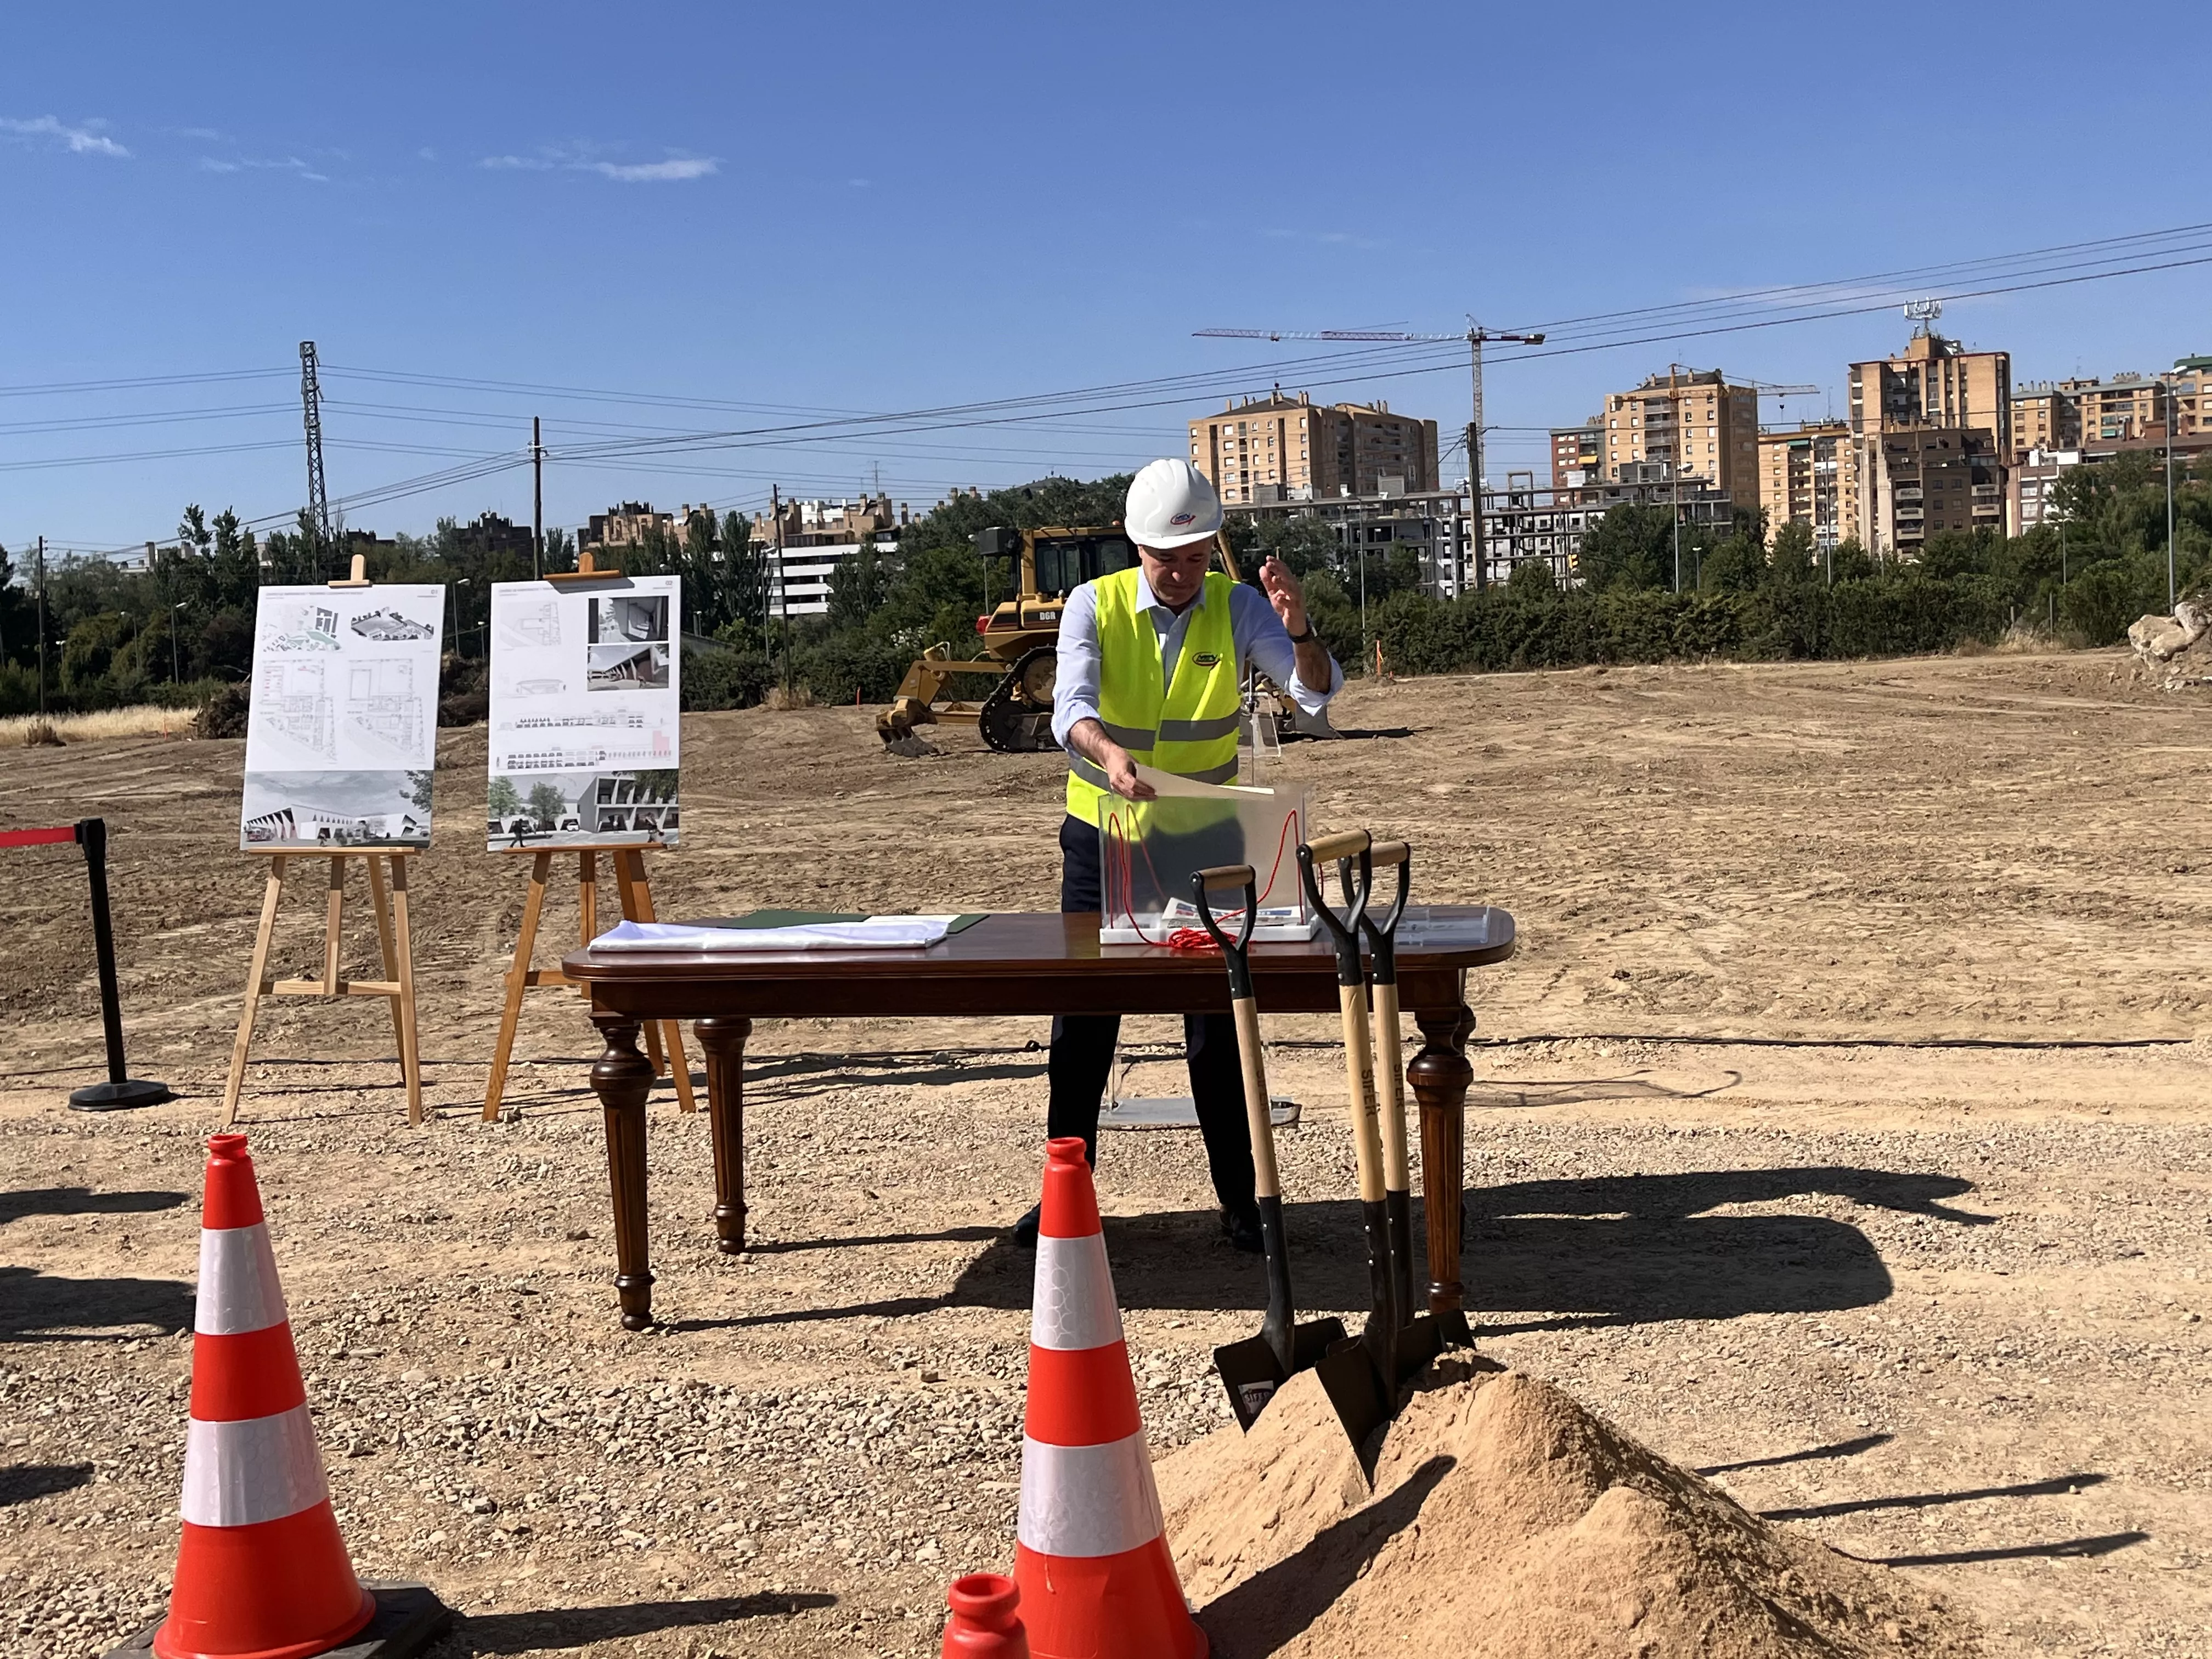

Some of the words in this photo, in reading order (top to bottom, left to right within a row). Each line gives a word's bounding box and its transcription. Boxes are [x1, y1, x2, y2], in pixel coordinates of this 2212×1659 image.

[1039, 611, 1056, 620] D6R
[1256, 1069, 1269, 1114] SIFER
[1362, 1069, 1376, 1118] SIFER
[1394, 1063, 1404, 1108] SIFER
